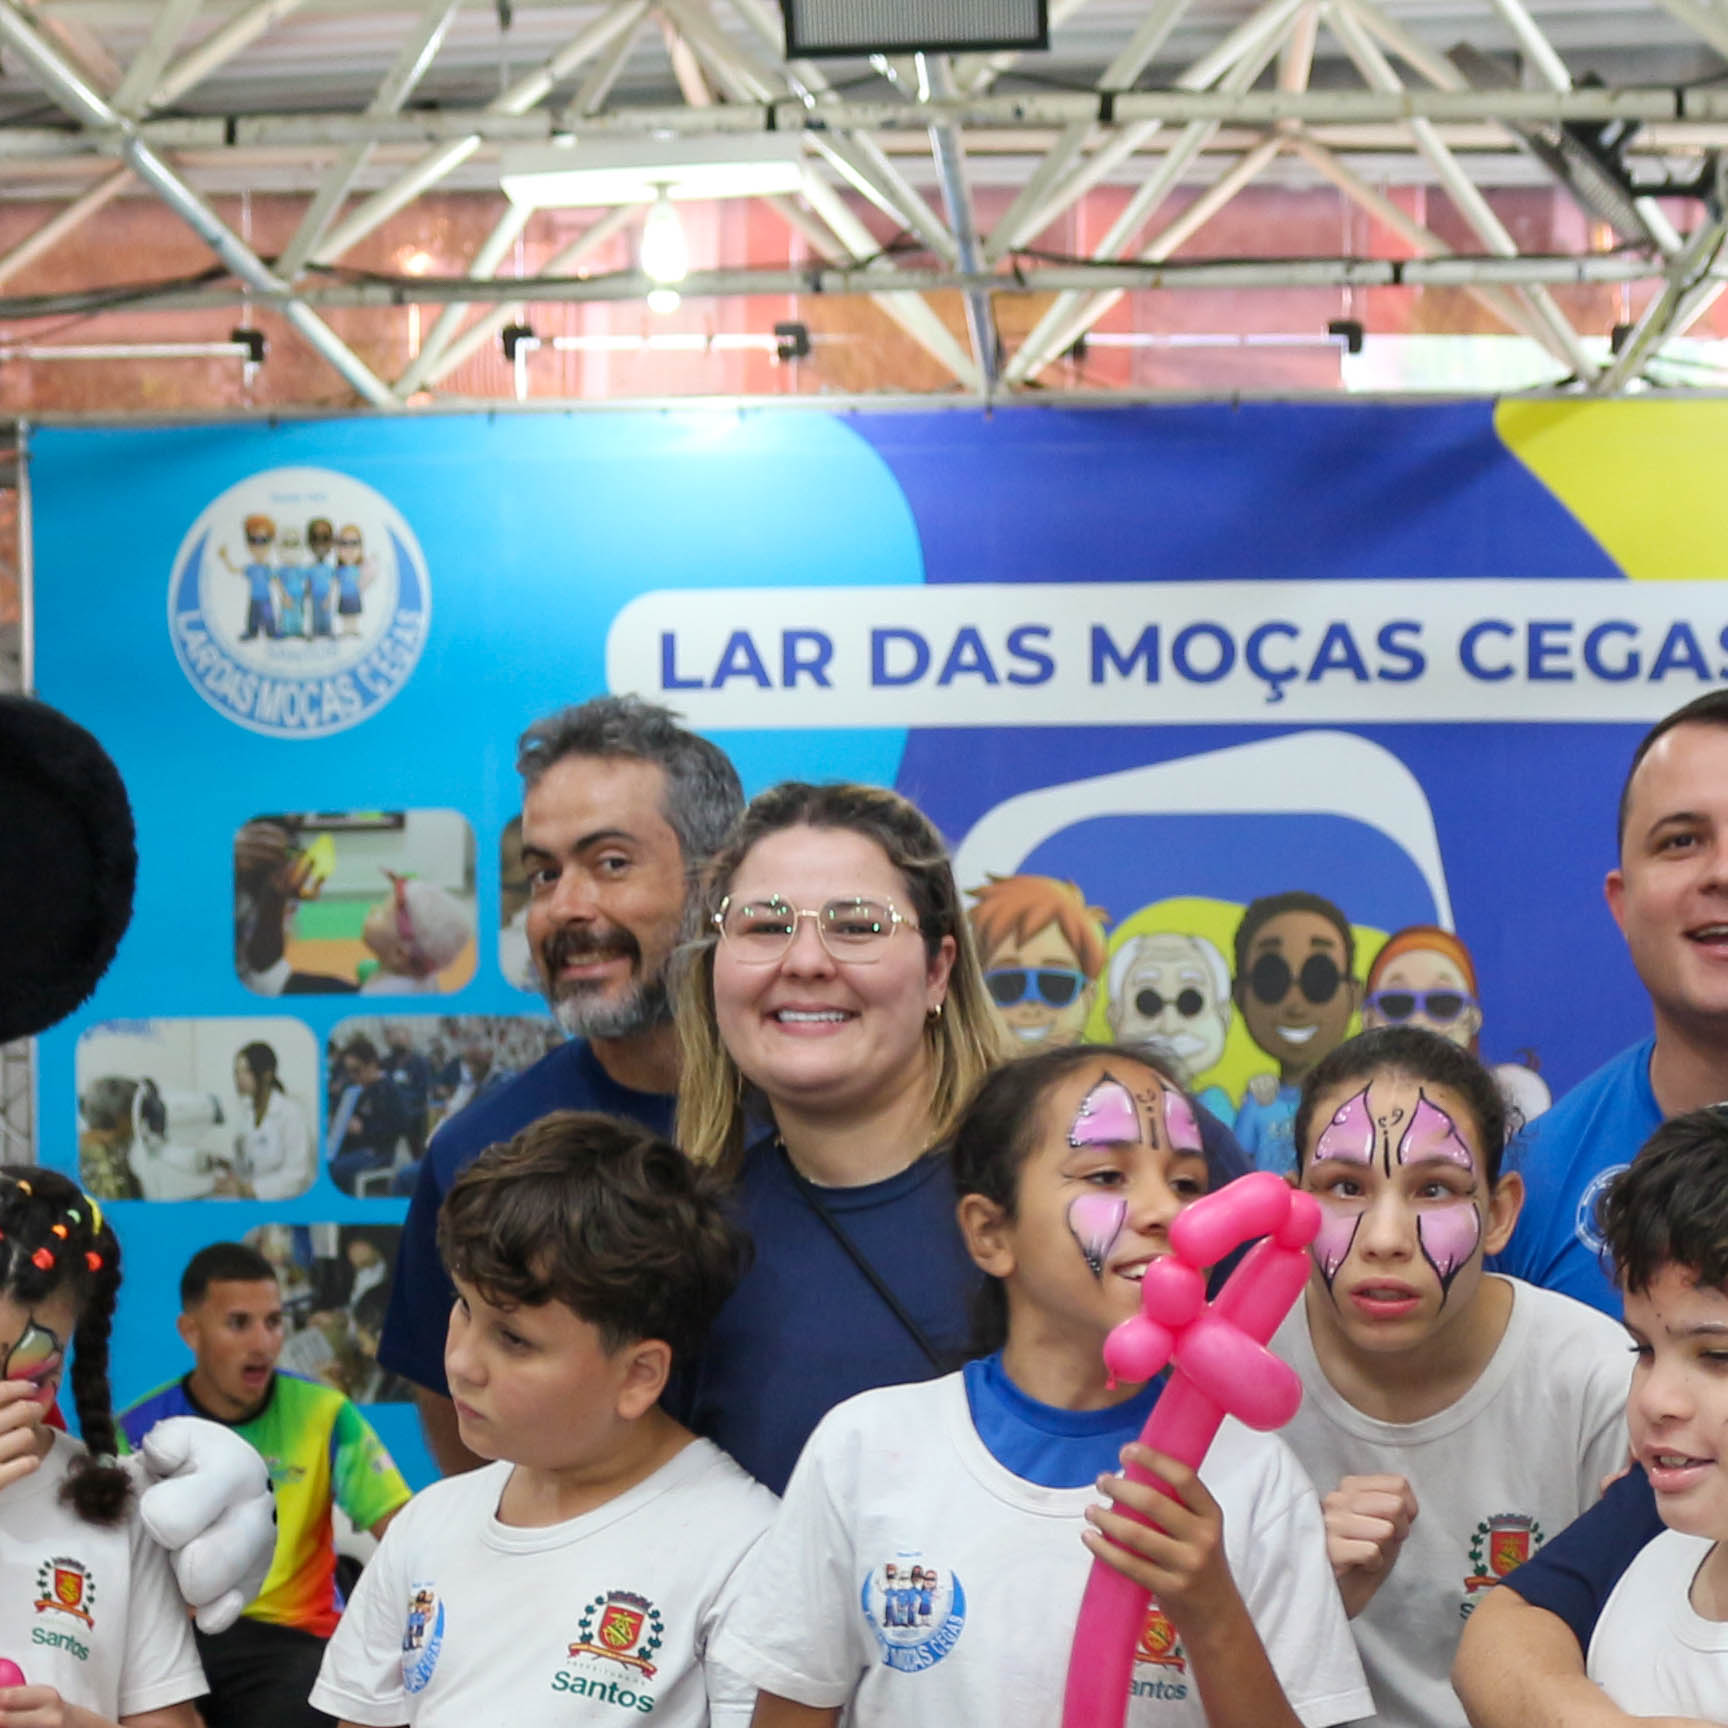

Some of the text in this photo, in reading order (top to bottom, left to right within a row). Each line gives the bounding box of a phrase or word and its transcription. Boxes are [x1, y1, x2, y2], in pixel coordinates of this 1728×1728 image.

[660, 627, 836, 690] LAR
[870, 623, 1057, 688] DAS
[1090, 619, 1427, 704] MOÇAS
[551, 1670, 656, 1713] Santos
[1129, 1680, 1188, 1701] antos
